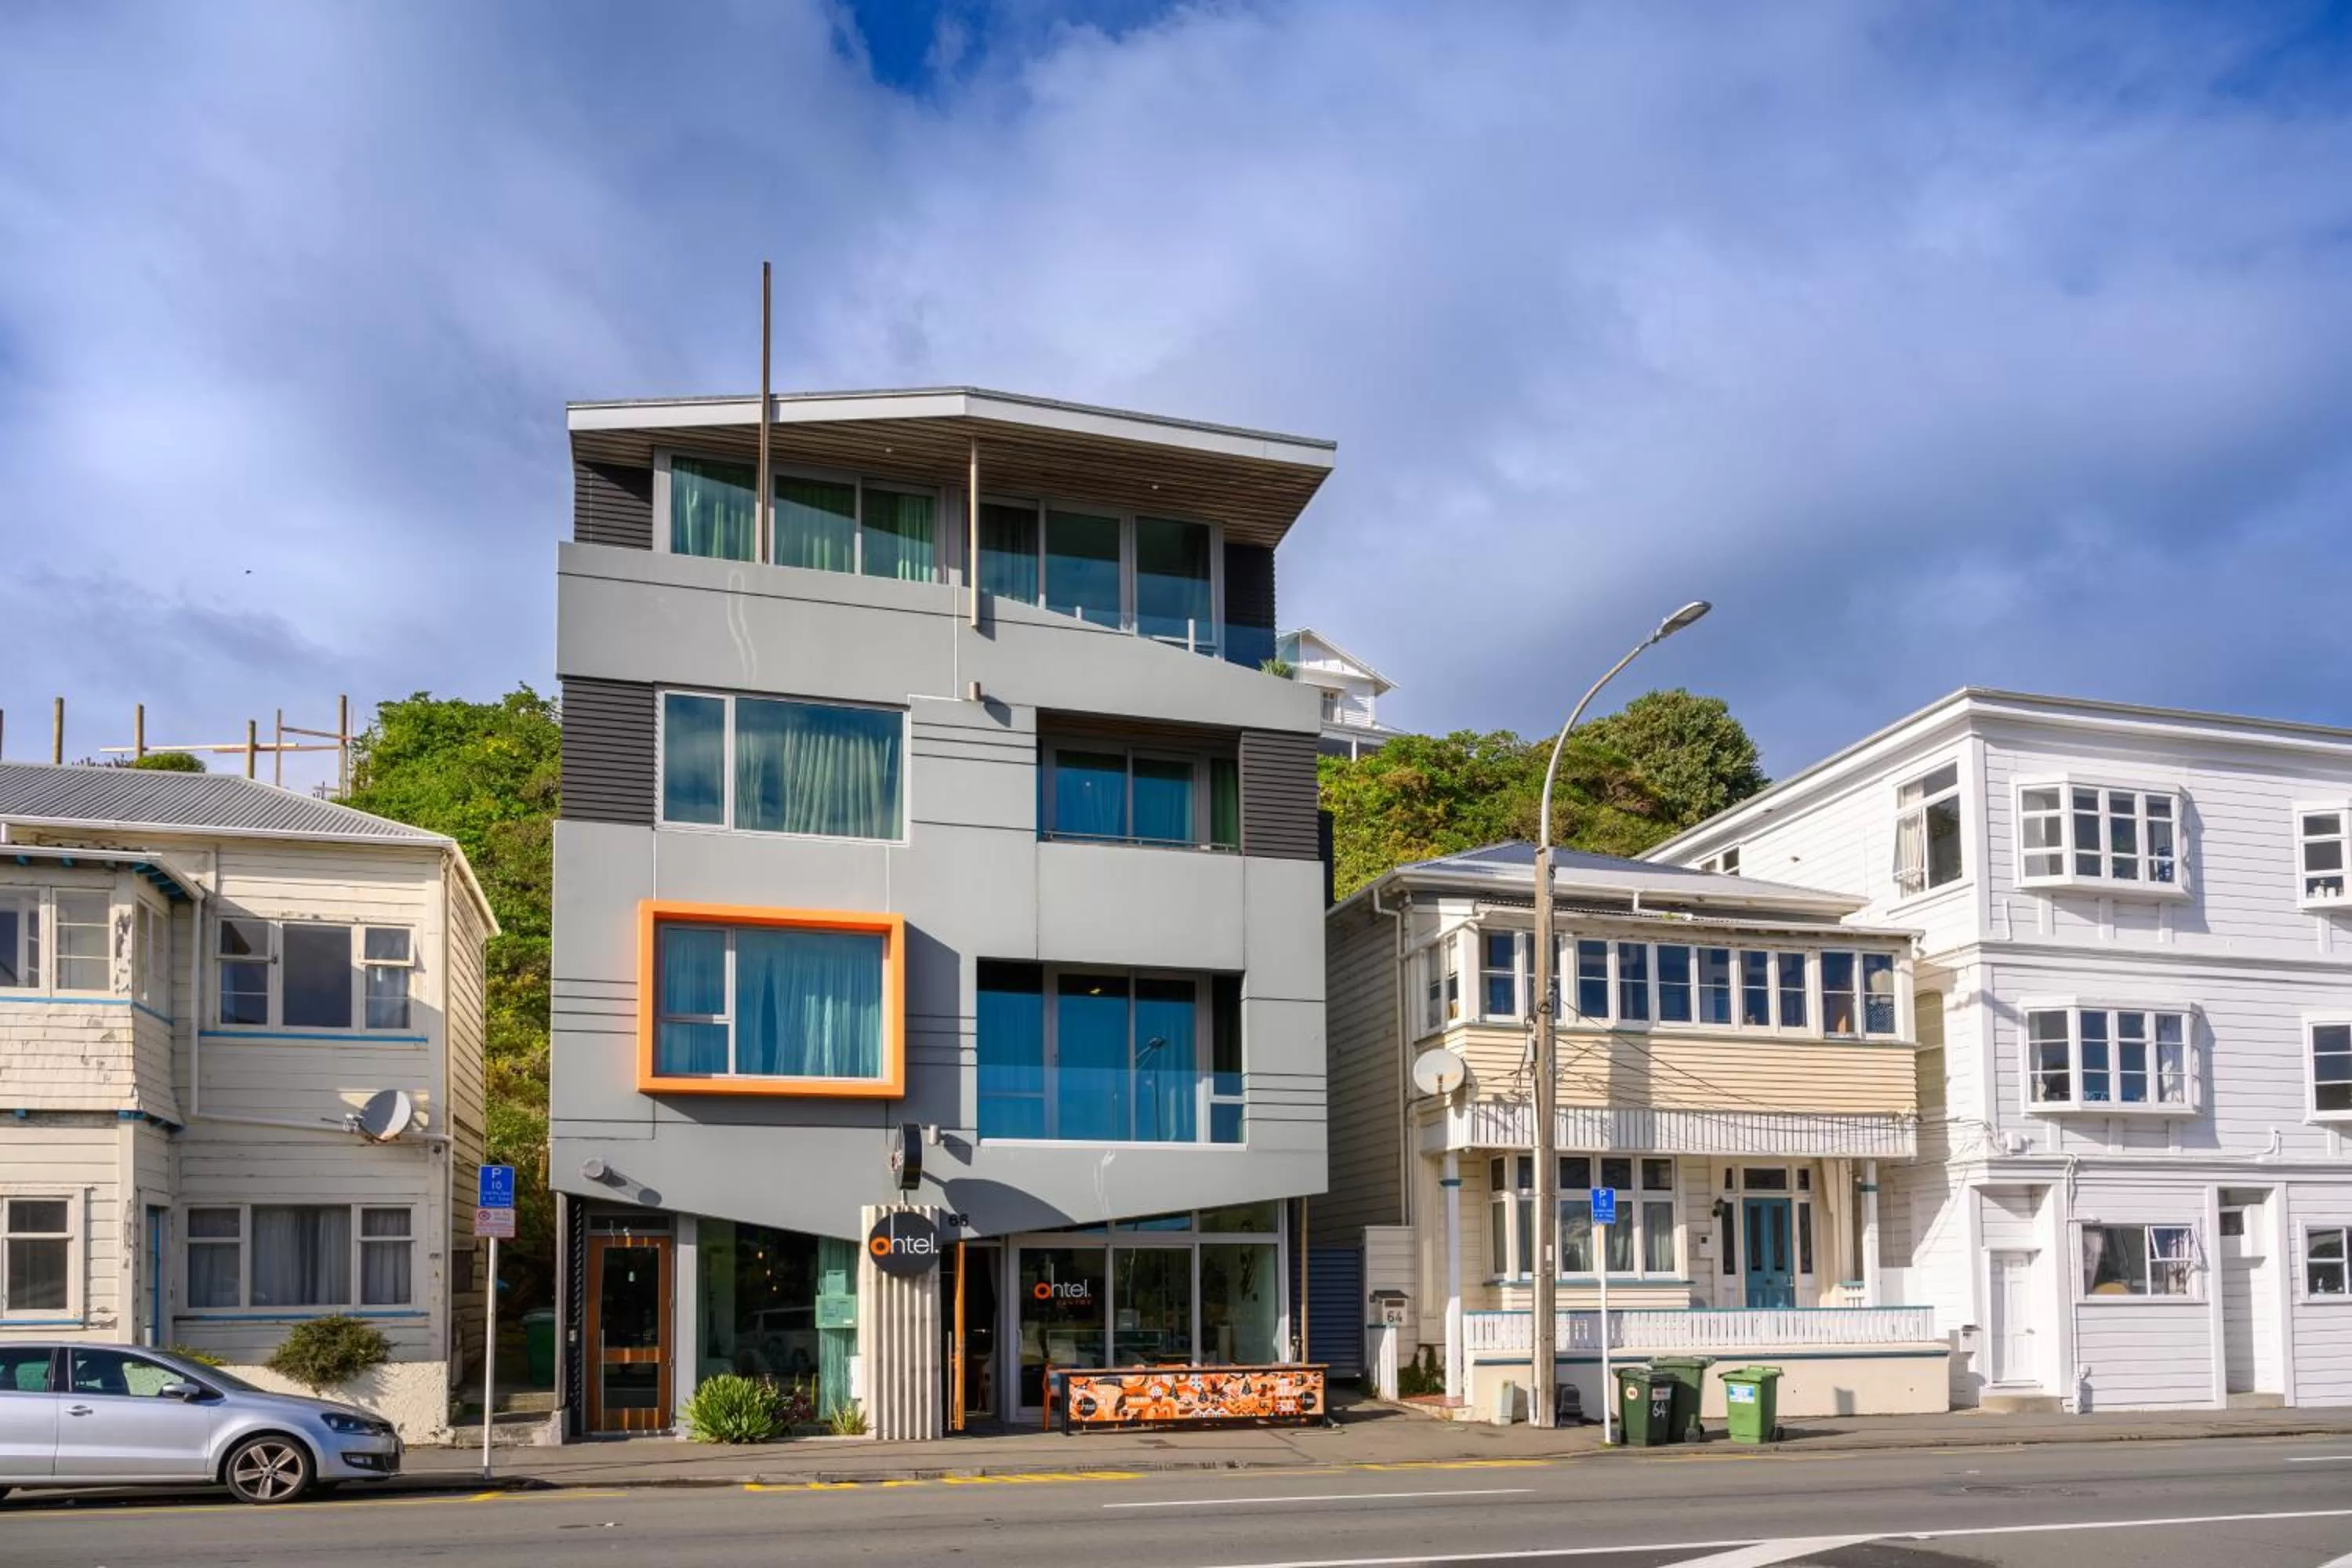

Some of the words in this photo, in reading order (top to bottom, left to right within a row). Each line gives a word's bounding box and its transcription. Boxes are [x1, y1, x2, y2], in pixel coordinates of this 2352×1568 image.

[492, 1167, 502, 1179] P
[1599, 1189, 1606, 1198] P
[869, 1213, 939, 1256] ohtel.
[1387, 1310, 1403, 1323] 64
[1652, 1401, 1668, 1417] 64
